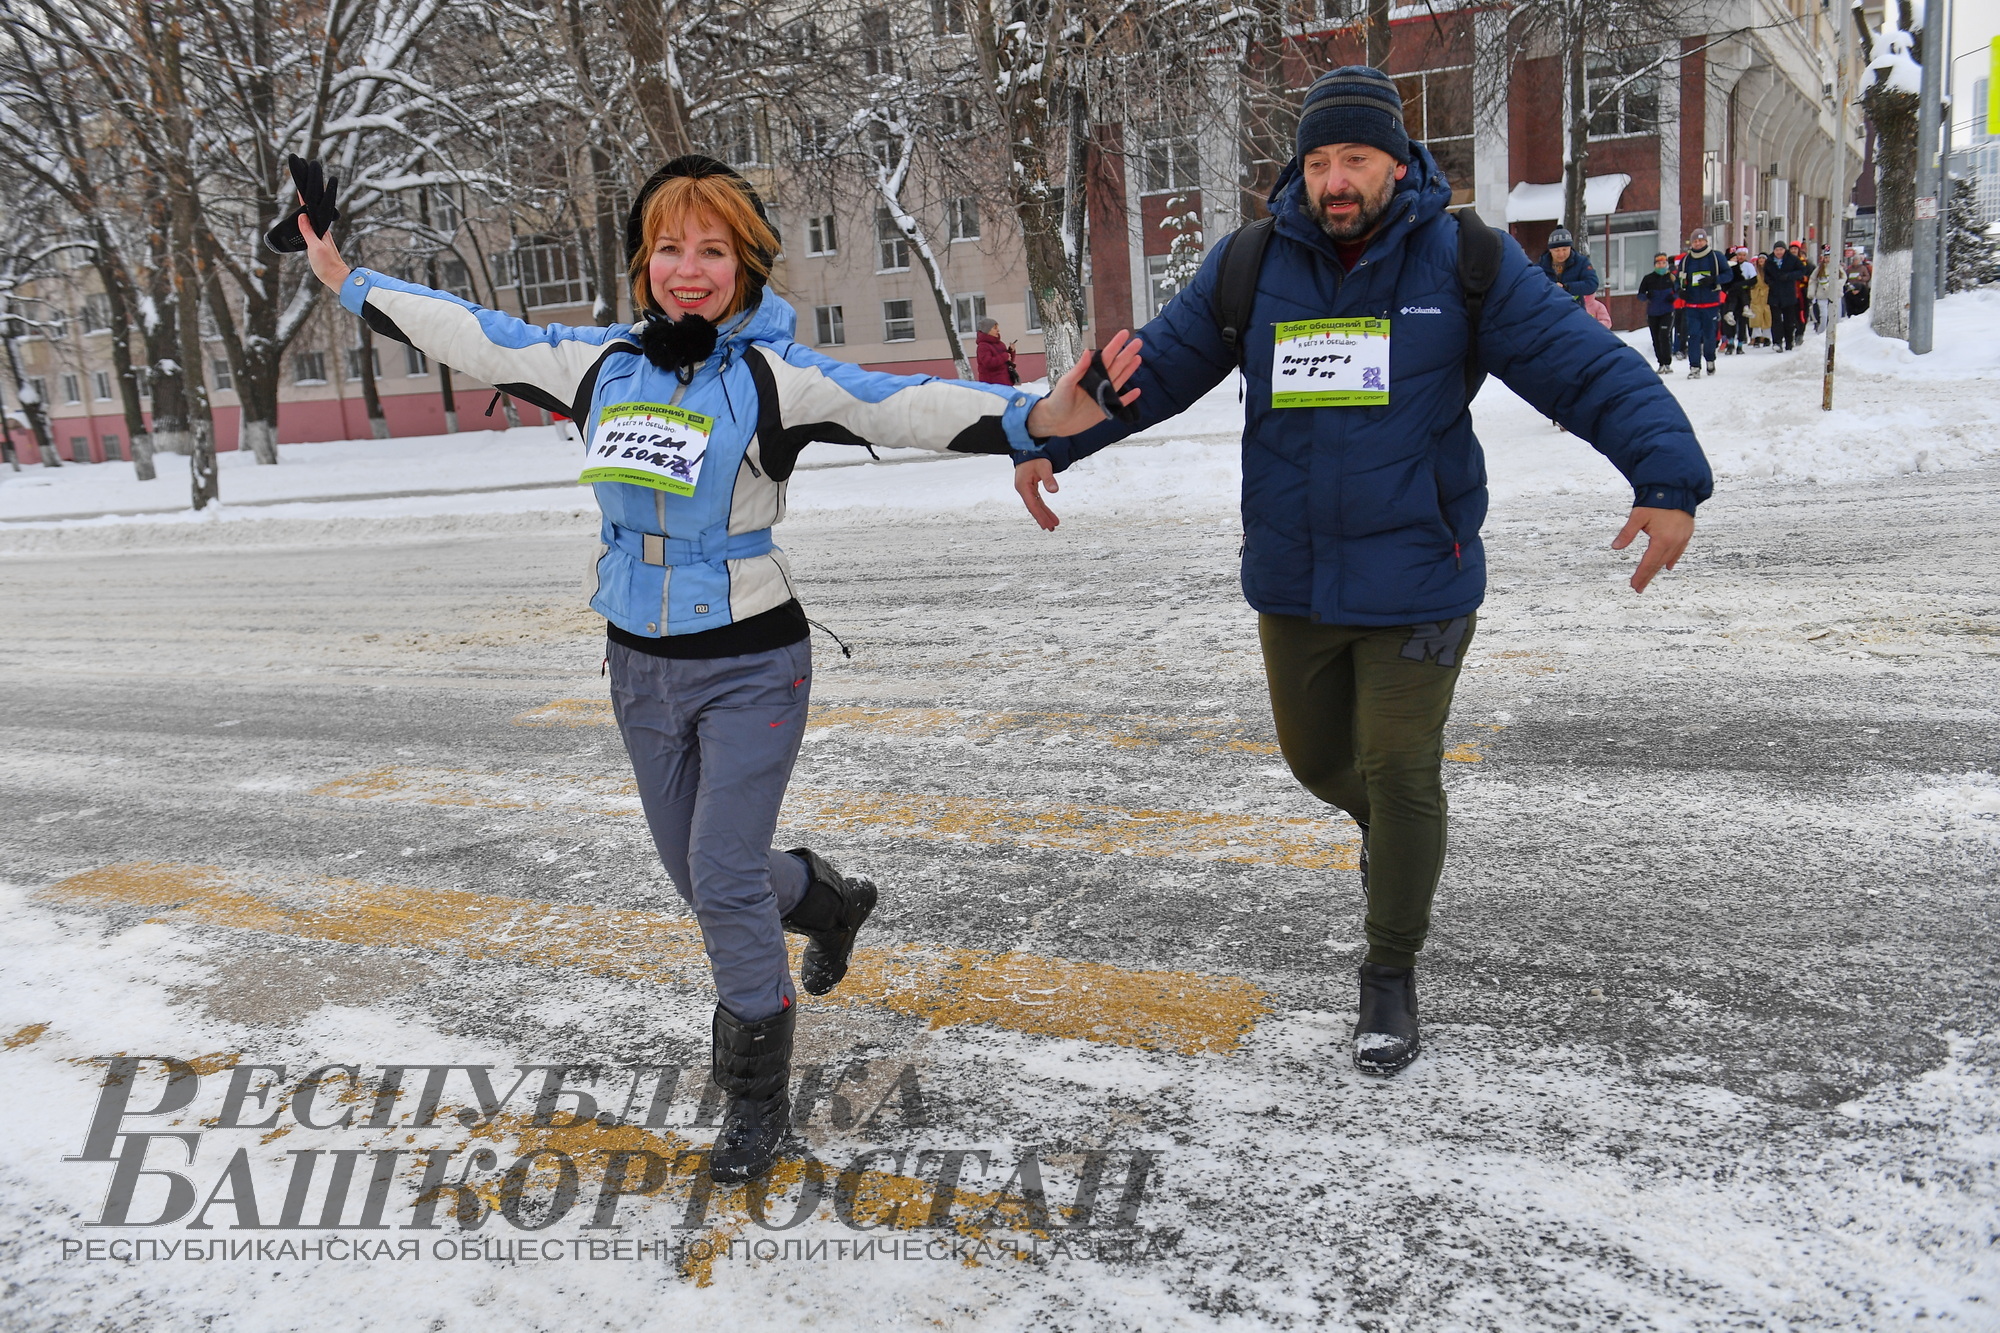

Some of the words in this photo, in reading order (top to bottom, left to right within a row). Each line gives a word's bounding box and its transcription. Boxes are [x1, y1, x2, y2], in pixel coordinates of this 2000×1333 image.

[1409, 306, 1442, 315] Columbia
[1283, 324, 1308, 333] Забег
[1310, 320, 1361, 331] обещаний
[1303, 339, 1318, 347] БЕГУ
[607, 405, 630, 415] Забег
[632, 403, 685, 418] обещаний
